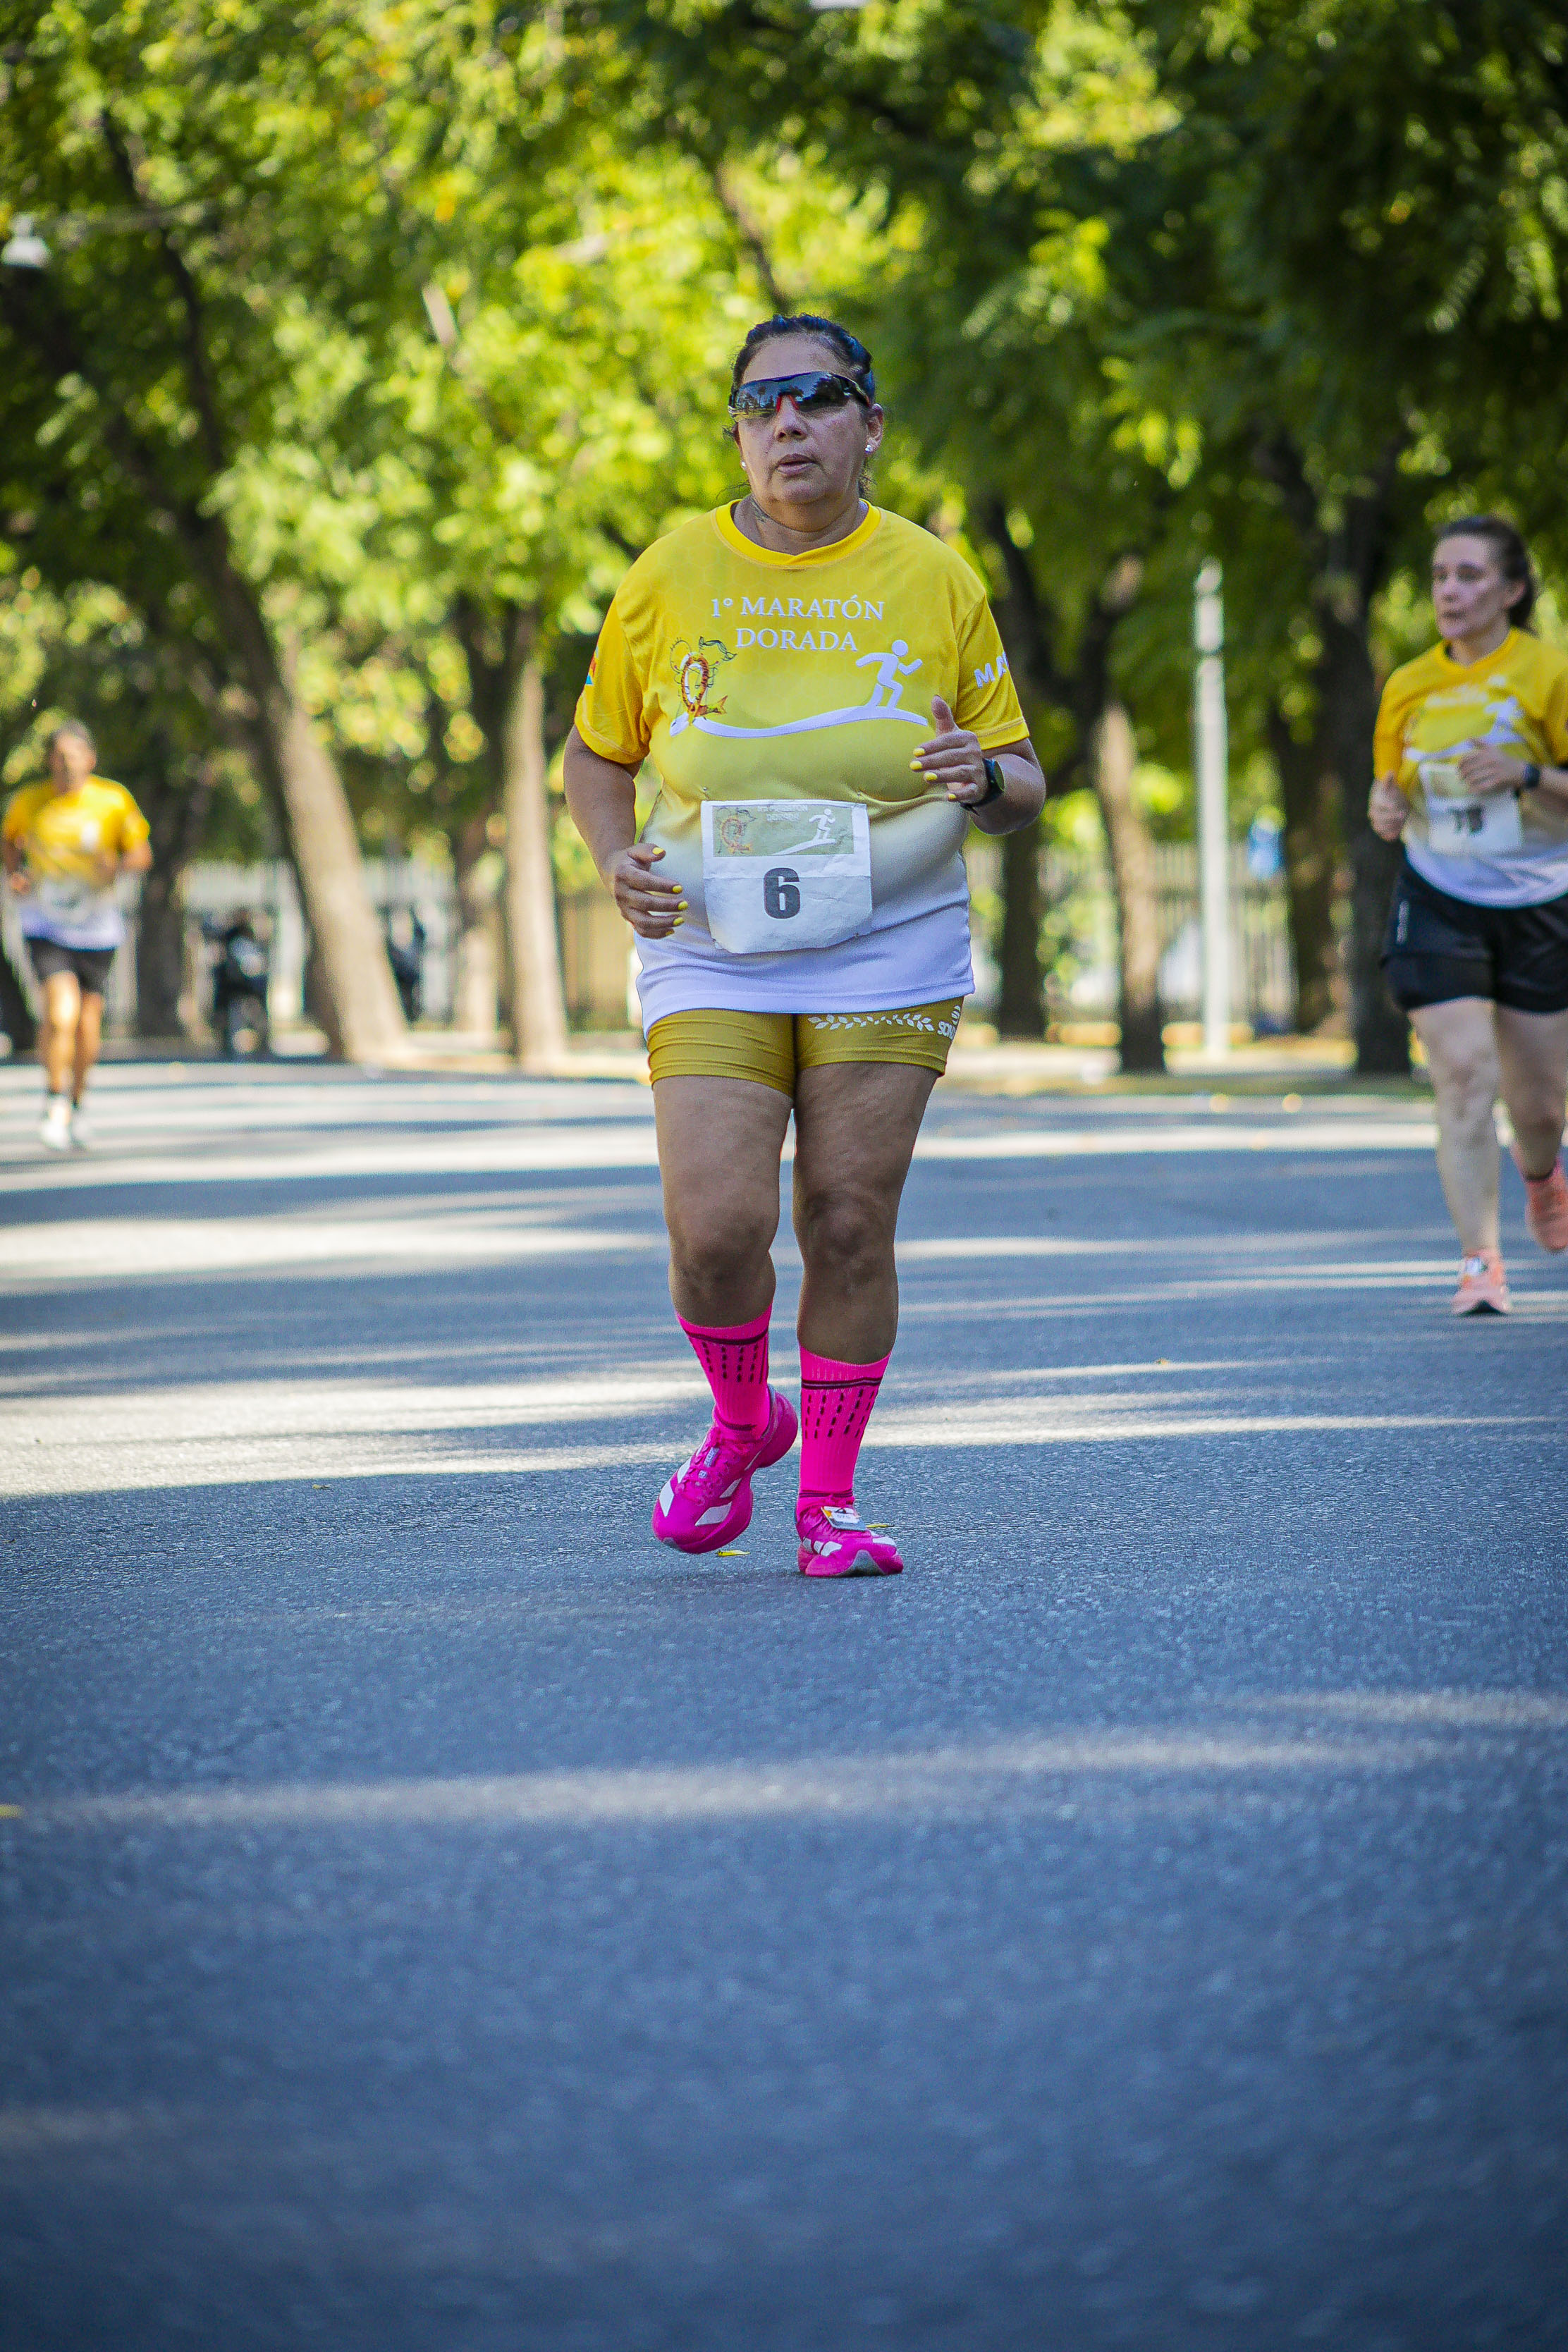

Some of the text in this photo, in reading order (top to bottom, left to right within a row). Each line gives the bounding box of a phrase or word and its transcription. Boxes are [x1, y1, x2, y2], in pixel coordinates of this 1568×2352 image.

[740, 594, 886, 621] MARATÓN
[735, 627, 858, 651] DORADA
[764, 867, 801, 919] 6
